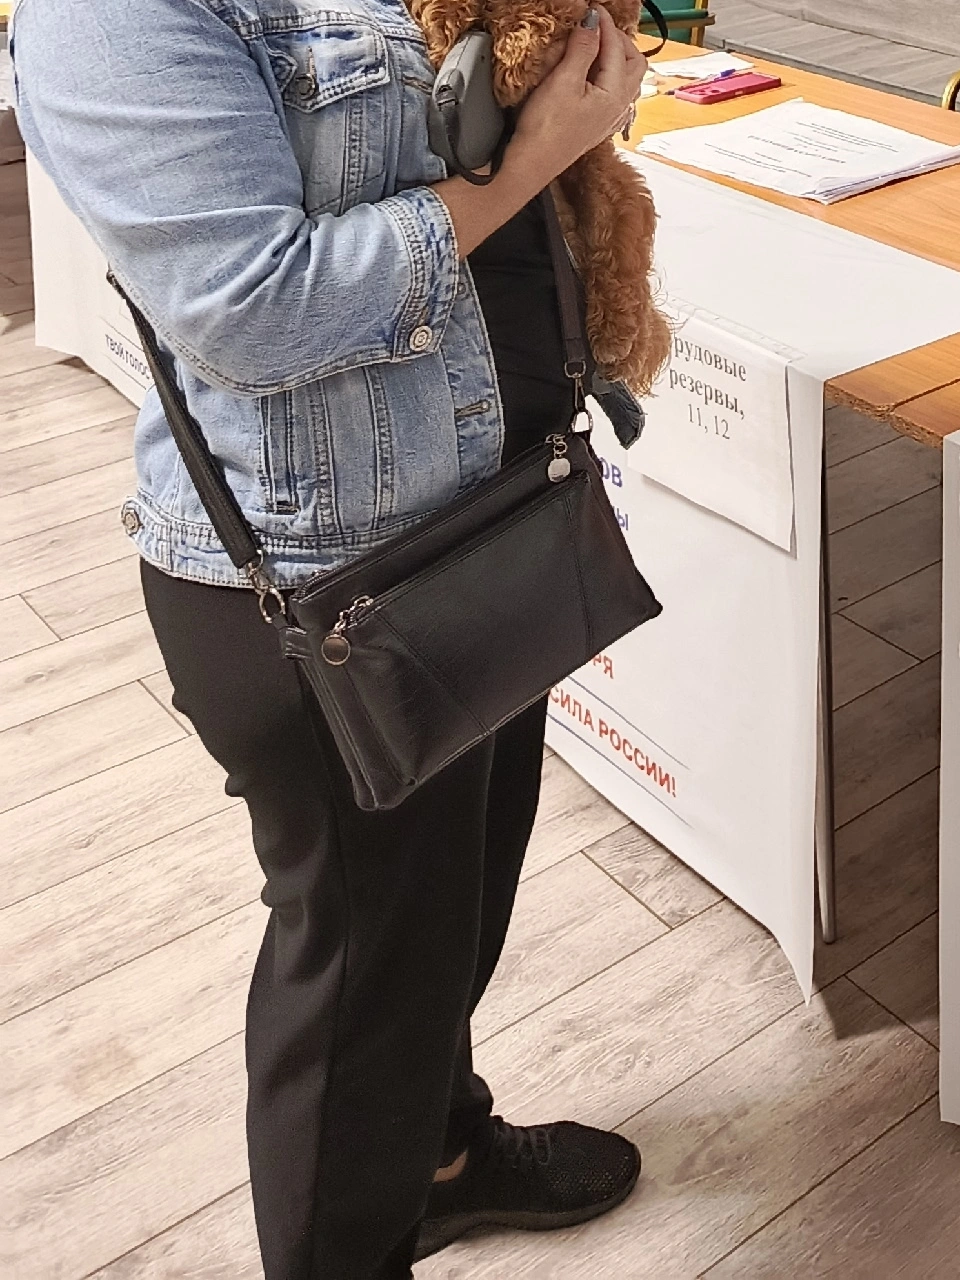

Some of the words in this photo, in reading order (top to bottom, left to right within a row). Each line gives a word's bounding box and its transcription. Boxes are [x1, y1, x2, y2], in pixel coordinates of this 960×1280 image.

[105, 333, 125, 361] ТВОЙ
[673, 335, 748, 382] рудовые
[669, 367, 746, 420] резервы,
[687, 403, 709, 434] 11,
[714, 415, 731, 440] 12
[549, 685, 595, 732] СИЛА
[599, 717, 677, 798] РОССИИ!
